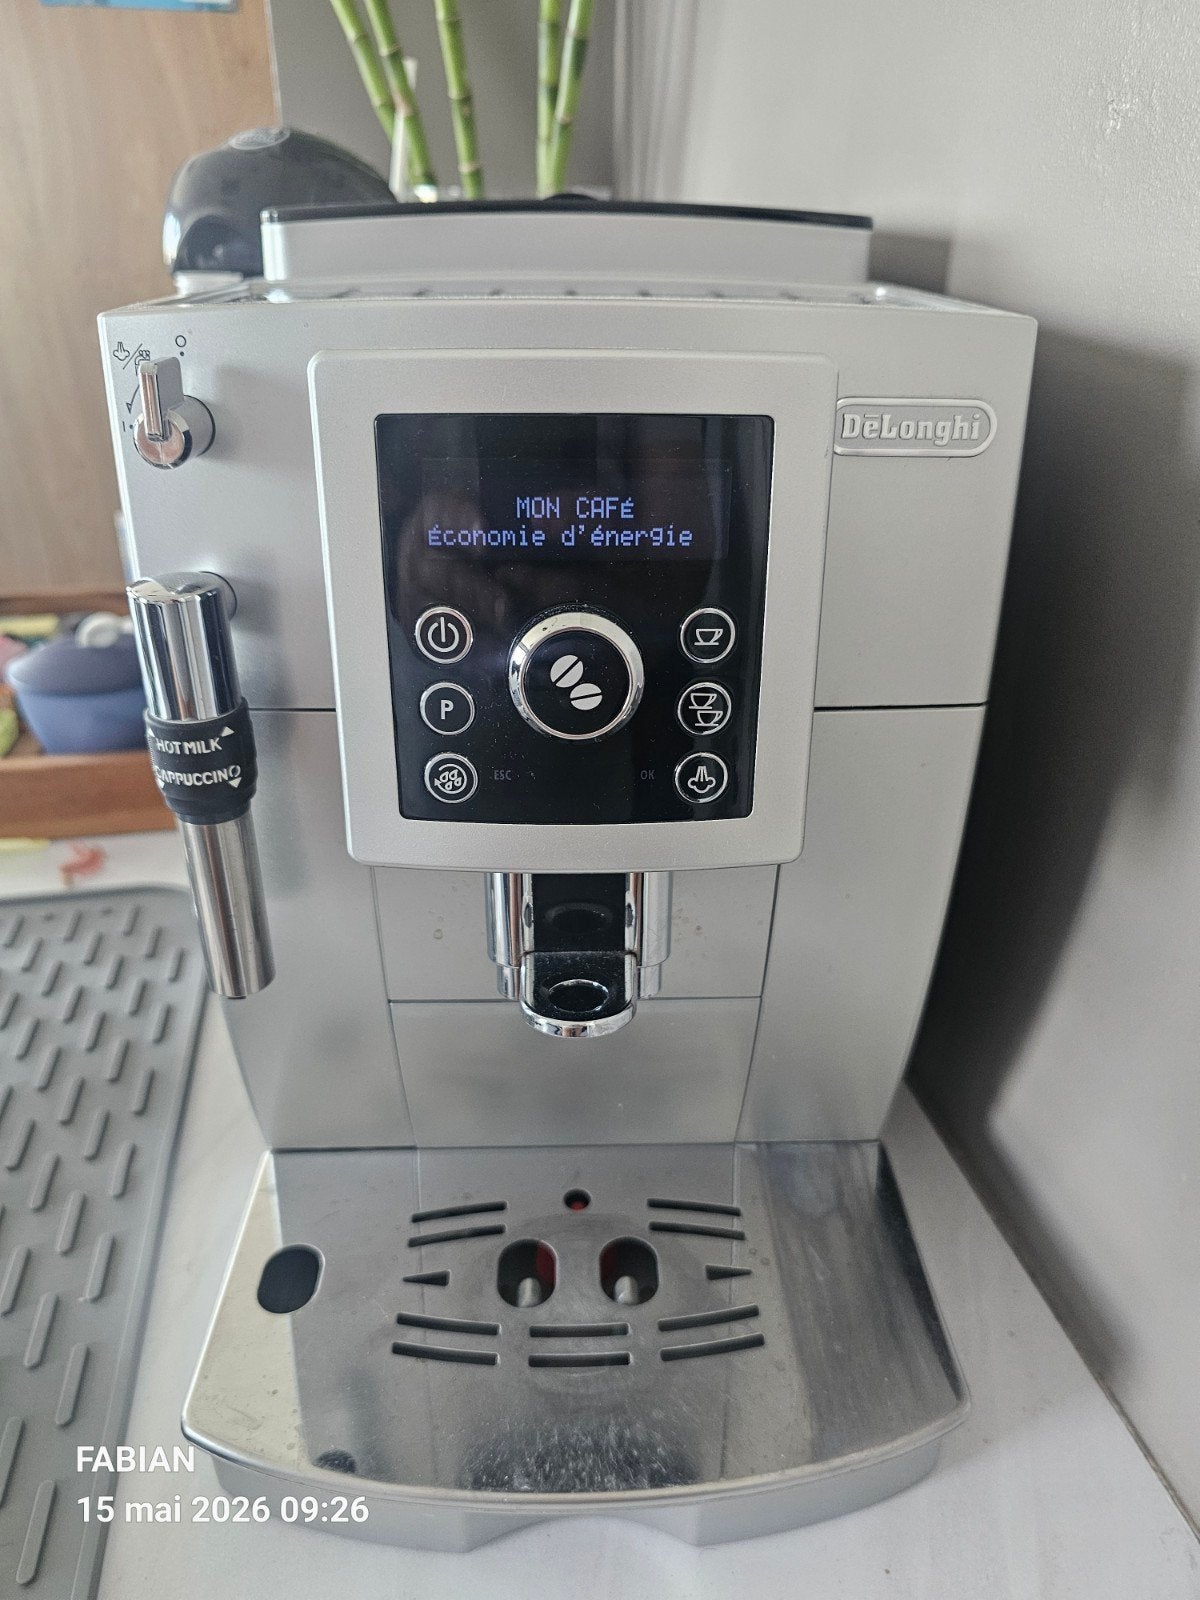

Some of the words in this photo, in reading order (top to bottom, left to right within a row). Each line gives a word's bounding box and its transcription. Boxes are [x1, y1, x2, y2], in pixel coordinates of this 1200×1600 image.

[516, 496, 560, 519] MON
[427, 524, 546, 547] Économie
[561, 524, 693, 547] d'énergie
[440, 699, 454, 720] P
[156, 738, 181, 755] HOT
[181, 737, 222, 755] MILK
[493, 770, 512, 781] ESC
[640, 770, 655, 781] OK
